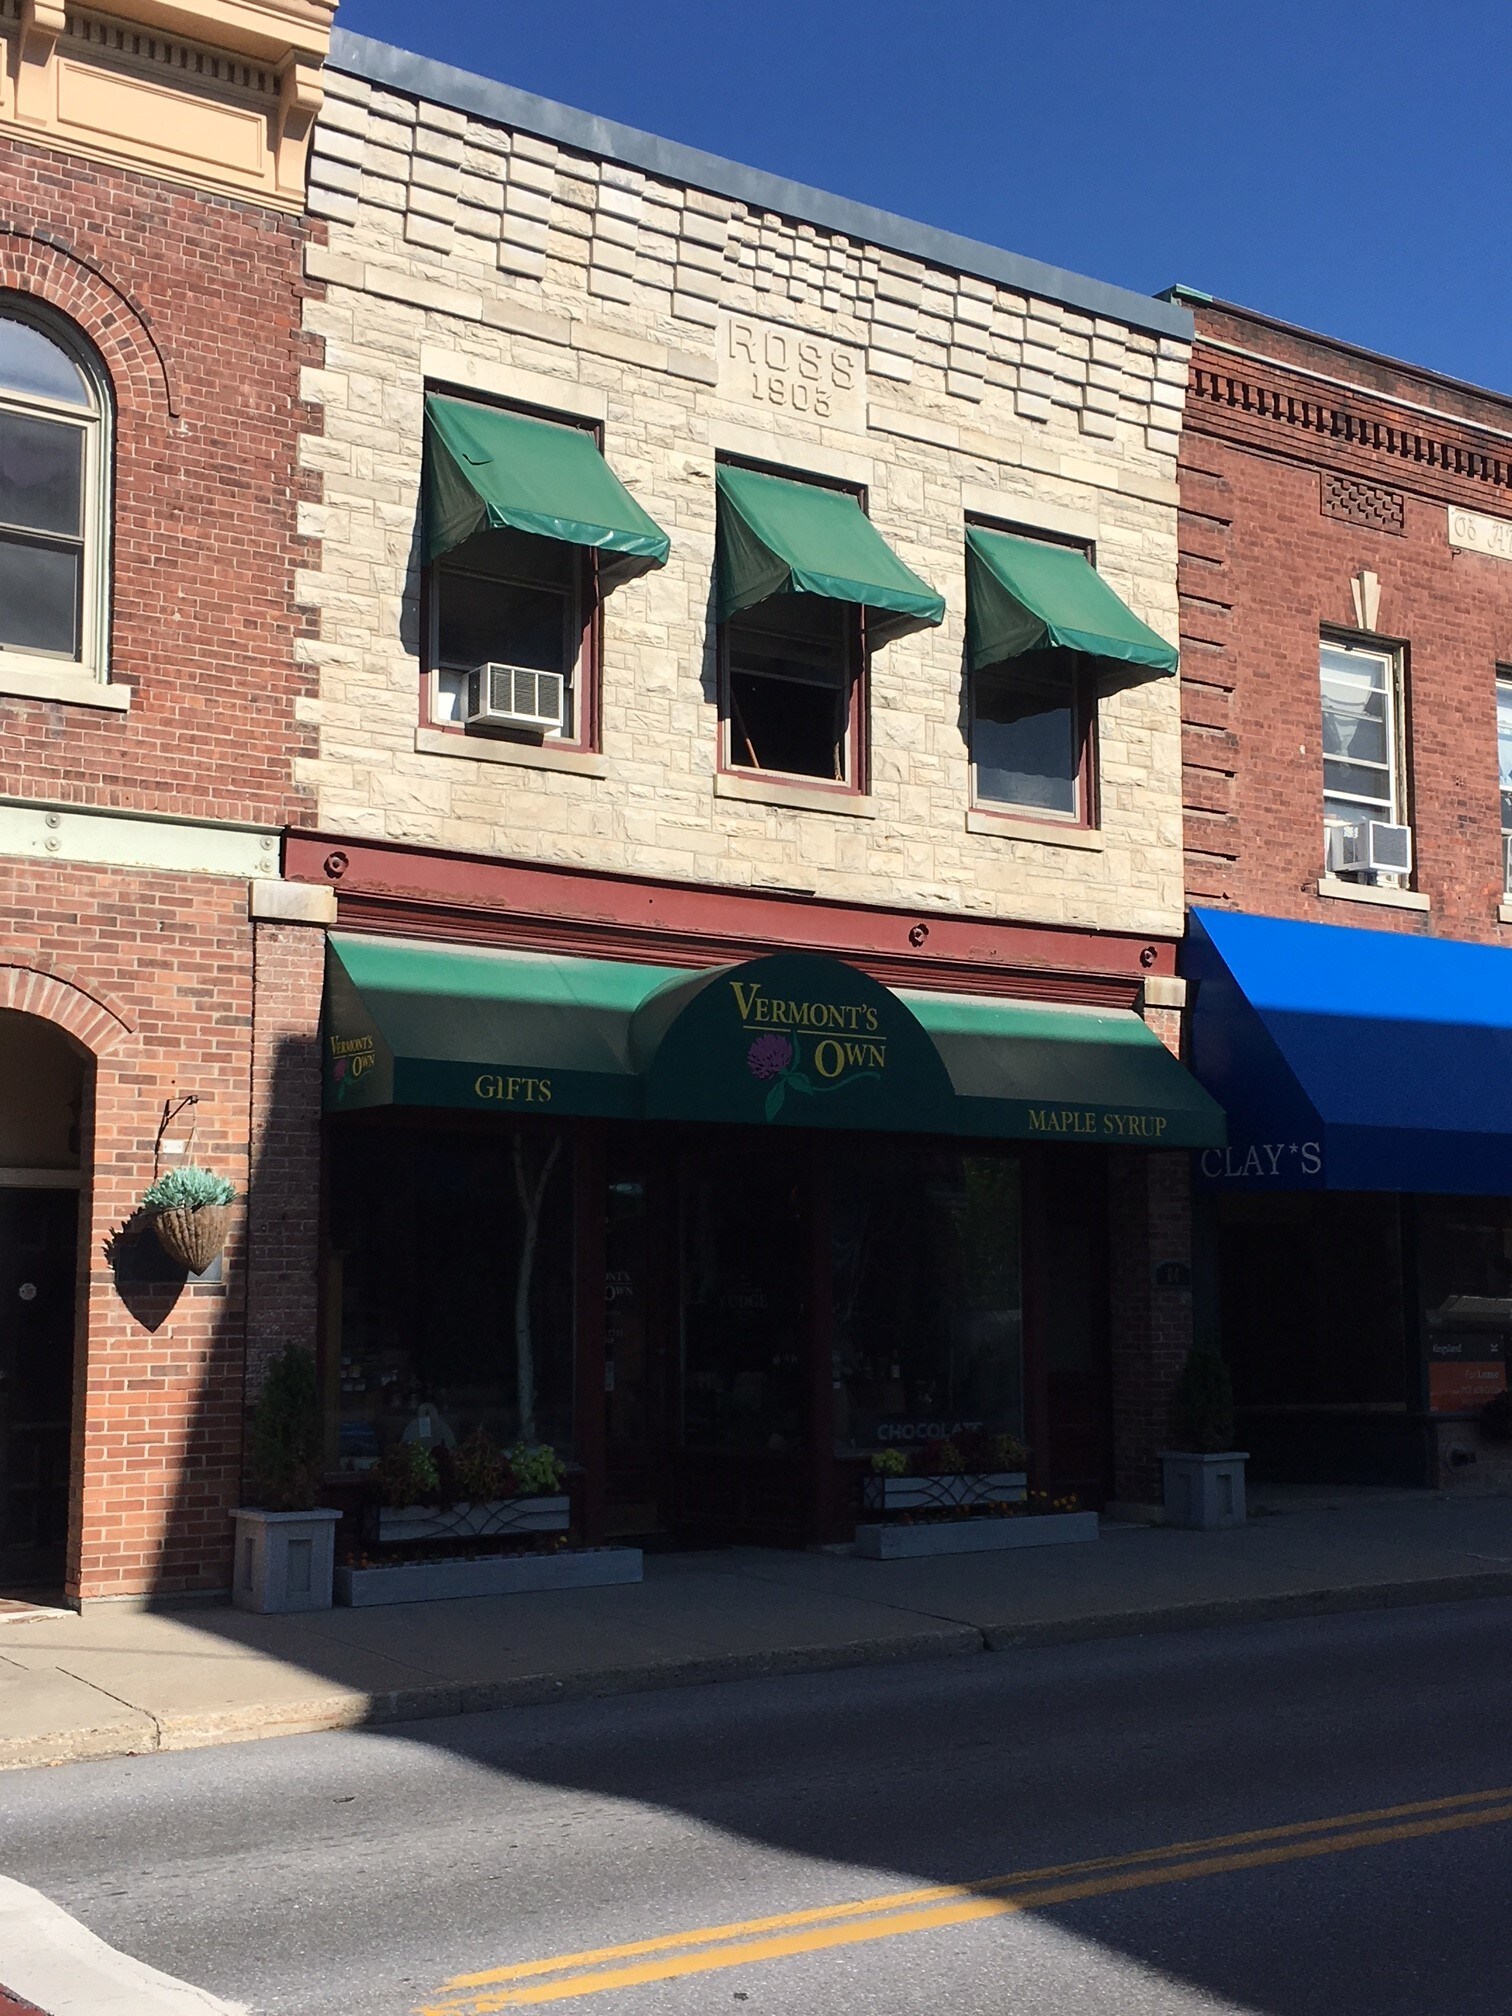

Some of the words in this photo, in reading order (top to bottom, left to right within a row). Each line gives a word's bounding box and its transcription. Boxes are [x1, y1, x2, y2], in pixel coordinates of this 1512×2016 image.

[729, 319, 855, 391] ROSS
[729, 981, 878, 1031] VERMONT'S
[330, 1035, 373, 1055] VERMONT'S
[814, 1040, 887, 1078] OWN
[352, 1054, 375, 1077] OWN
[474, 1074, 552, 1102] GIFTS
[1028, 1109, 1096, 1133] MAPLE
[1103, 1113, 1167, 1137] SYRUP
